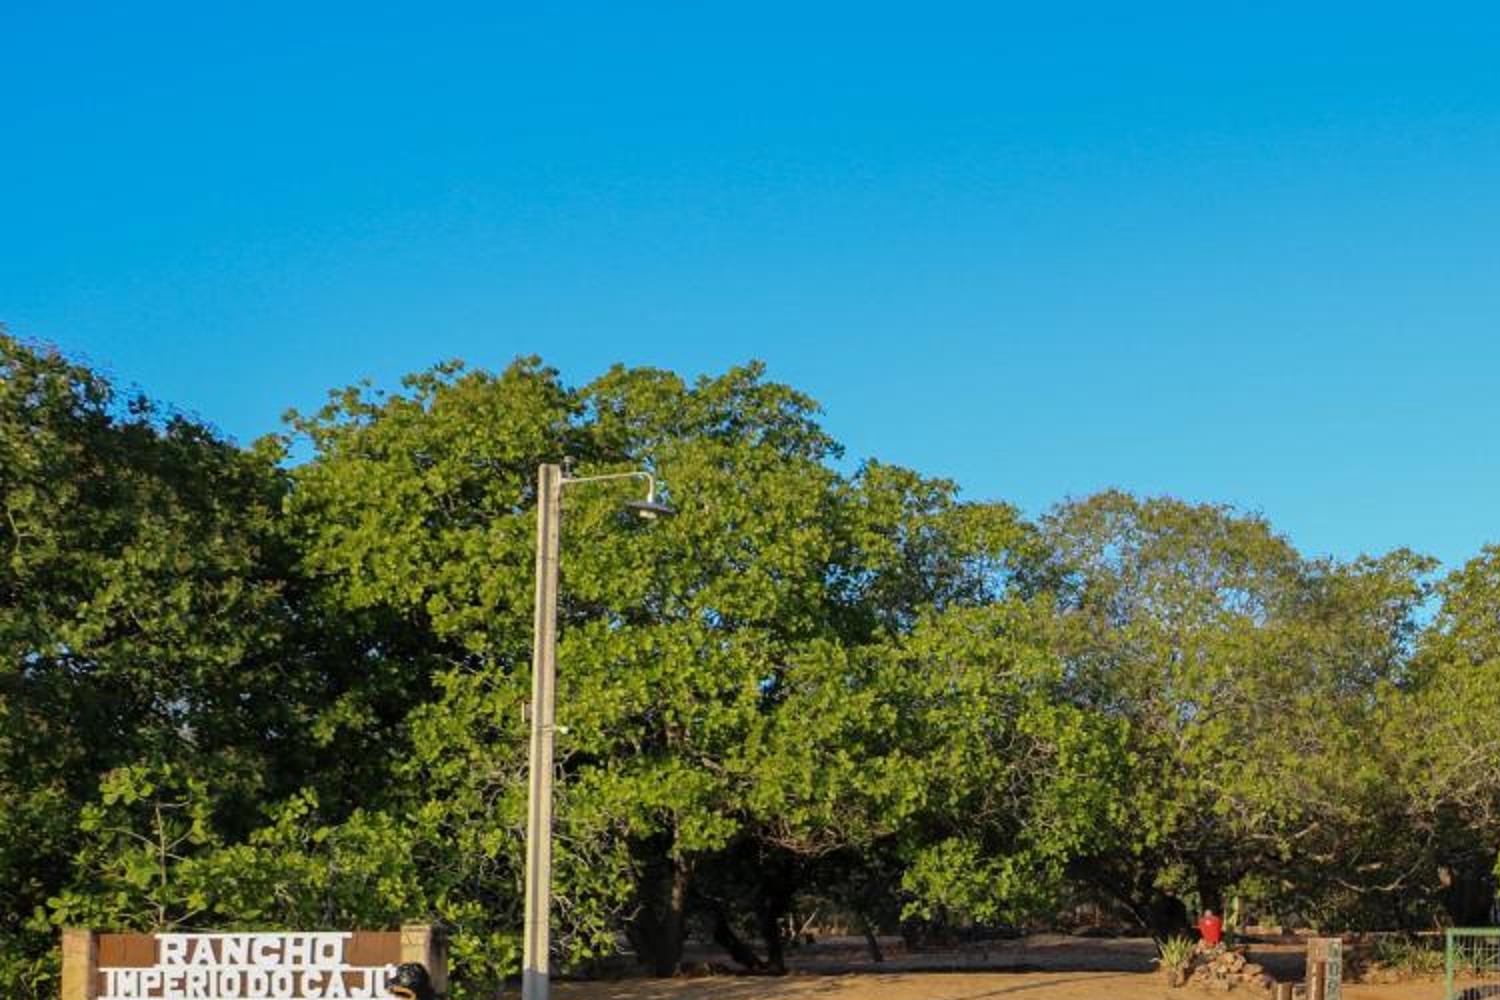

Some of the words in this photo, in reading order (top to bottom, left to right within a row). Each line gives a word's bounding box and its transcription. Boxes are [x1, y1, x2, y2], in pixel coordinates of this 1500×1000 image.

[159, 934, 345, 966] RANCHO
[105, 968, 242, 1000] IMPERIO
[249, 968, 296, 1000] DO
